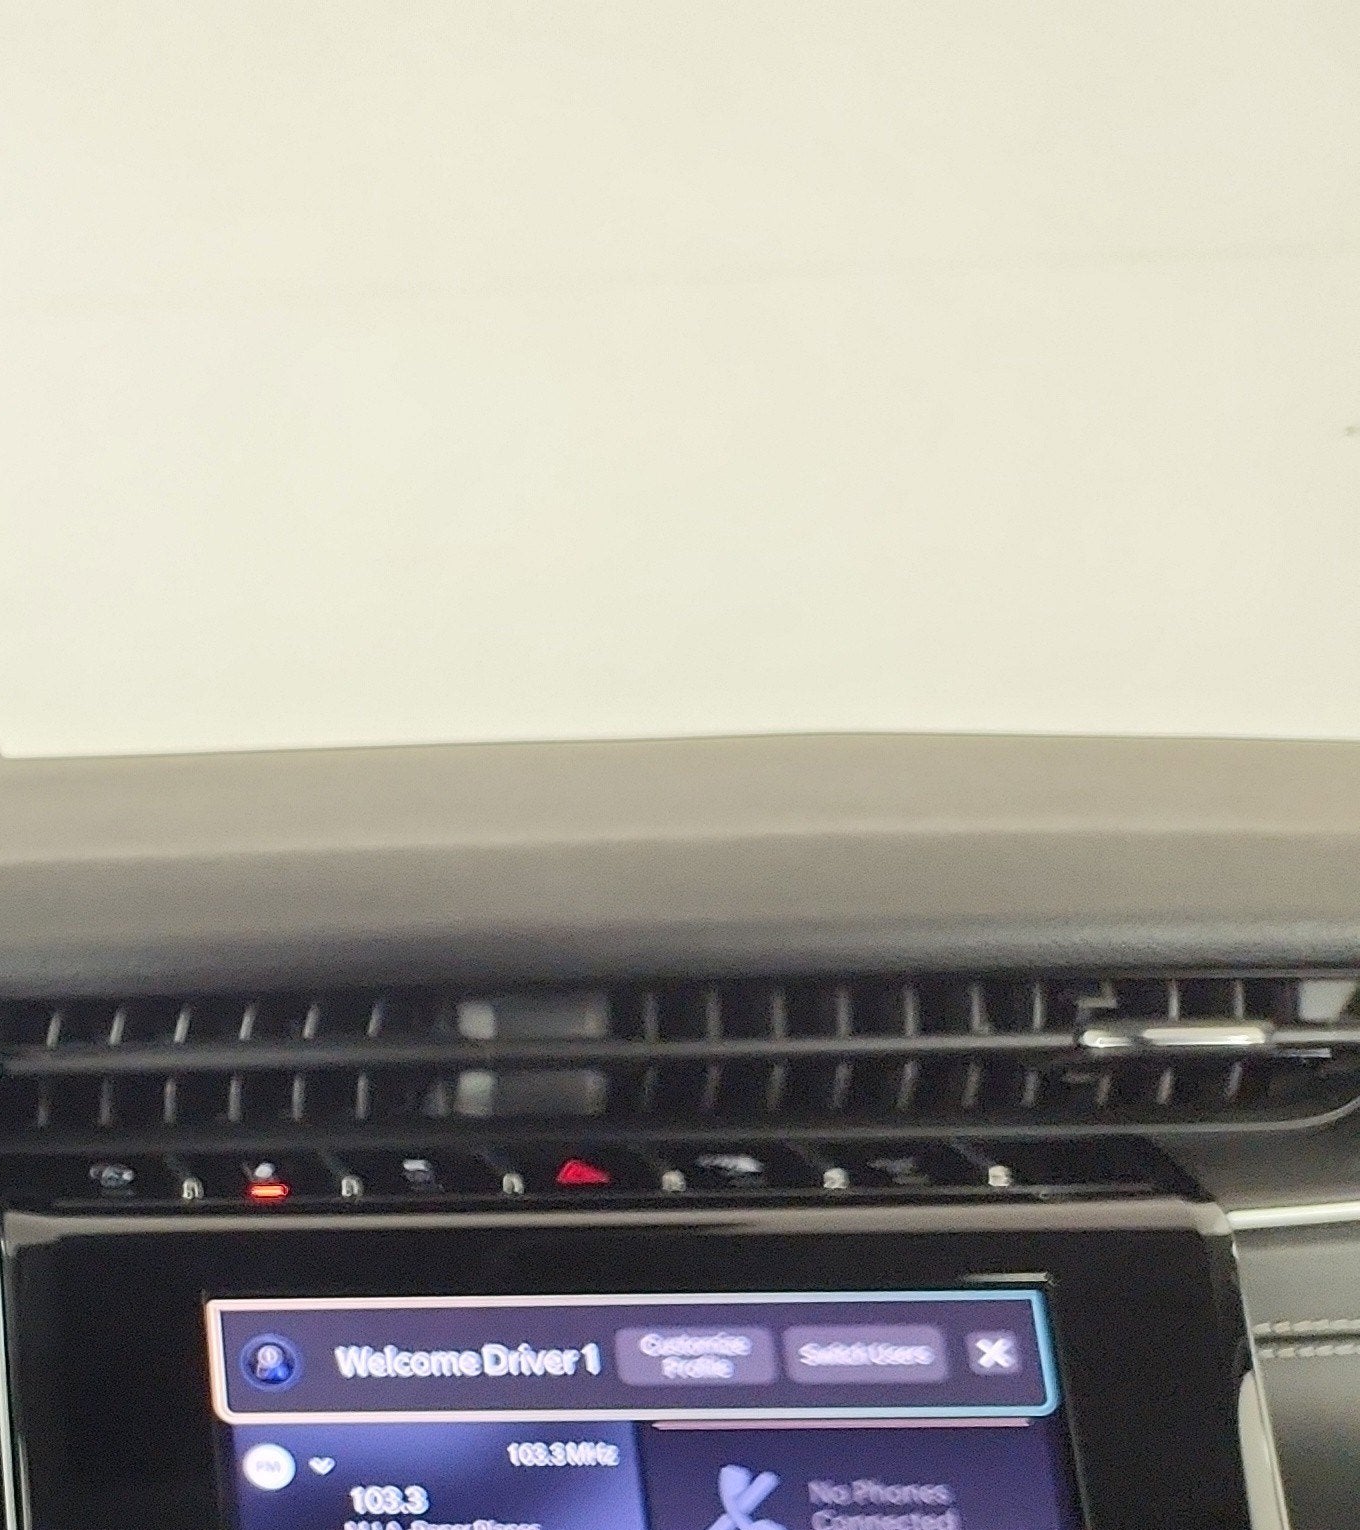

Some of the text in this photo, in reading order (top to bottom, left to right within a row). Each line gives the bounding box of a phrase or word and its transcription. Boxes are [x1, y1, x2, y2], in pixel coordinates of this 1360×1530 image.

[334, 1342, 601, 1378] Welcome Driver 1
[662, 1355, 735, 1379] Profile
[506, 1441, 621, 1467] 103.3 MHz
[349, 1485, 429, 1515] 103.3
[808, 1478, 956, 1506] No Phones
